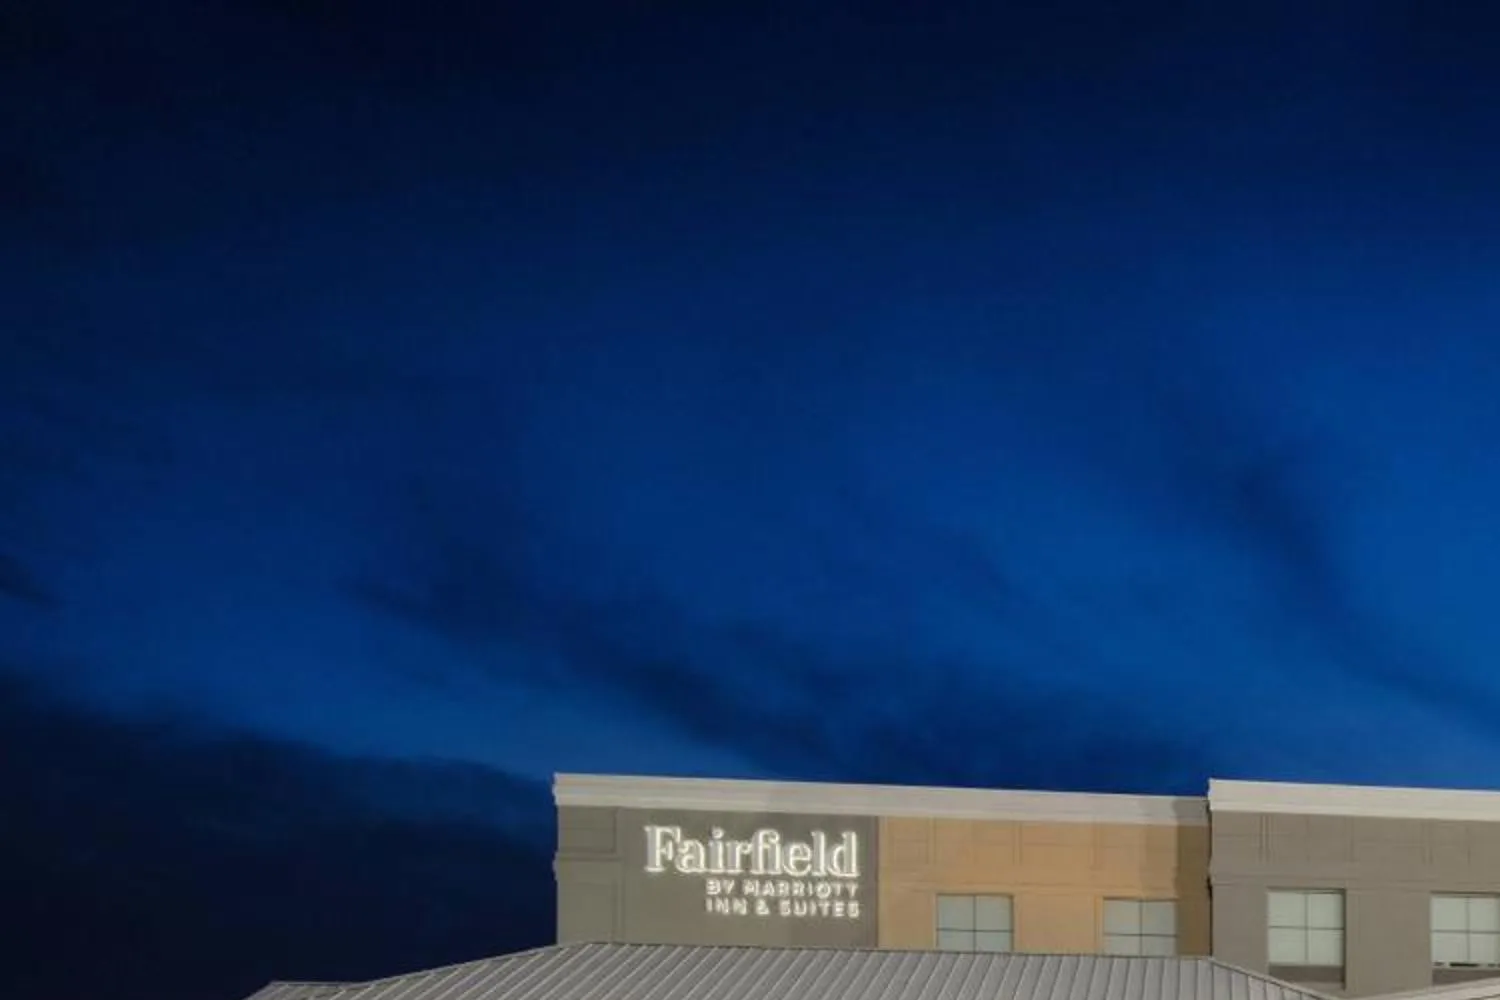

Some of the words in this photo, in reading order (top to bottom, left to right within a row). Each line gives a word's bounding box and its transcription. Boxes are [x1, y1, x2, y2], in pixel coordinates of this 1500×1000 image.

[643, 825, 860, 877] Fairfield
[705, 879, 736, 896] BY
[743, 879, 860, 899] MARRIOTT
[705, 898, 748, 915] INN
[755, 898, 771, 915] &
[779, 899, 860, 918] SUITES
